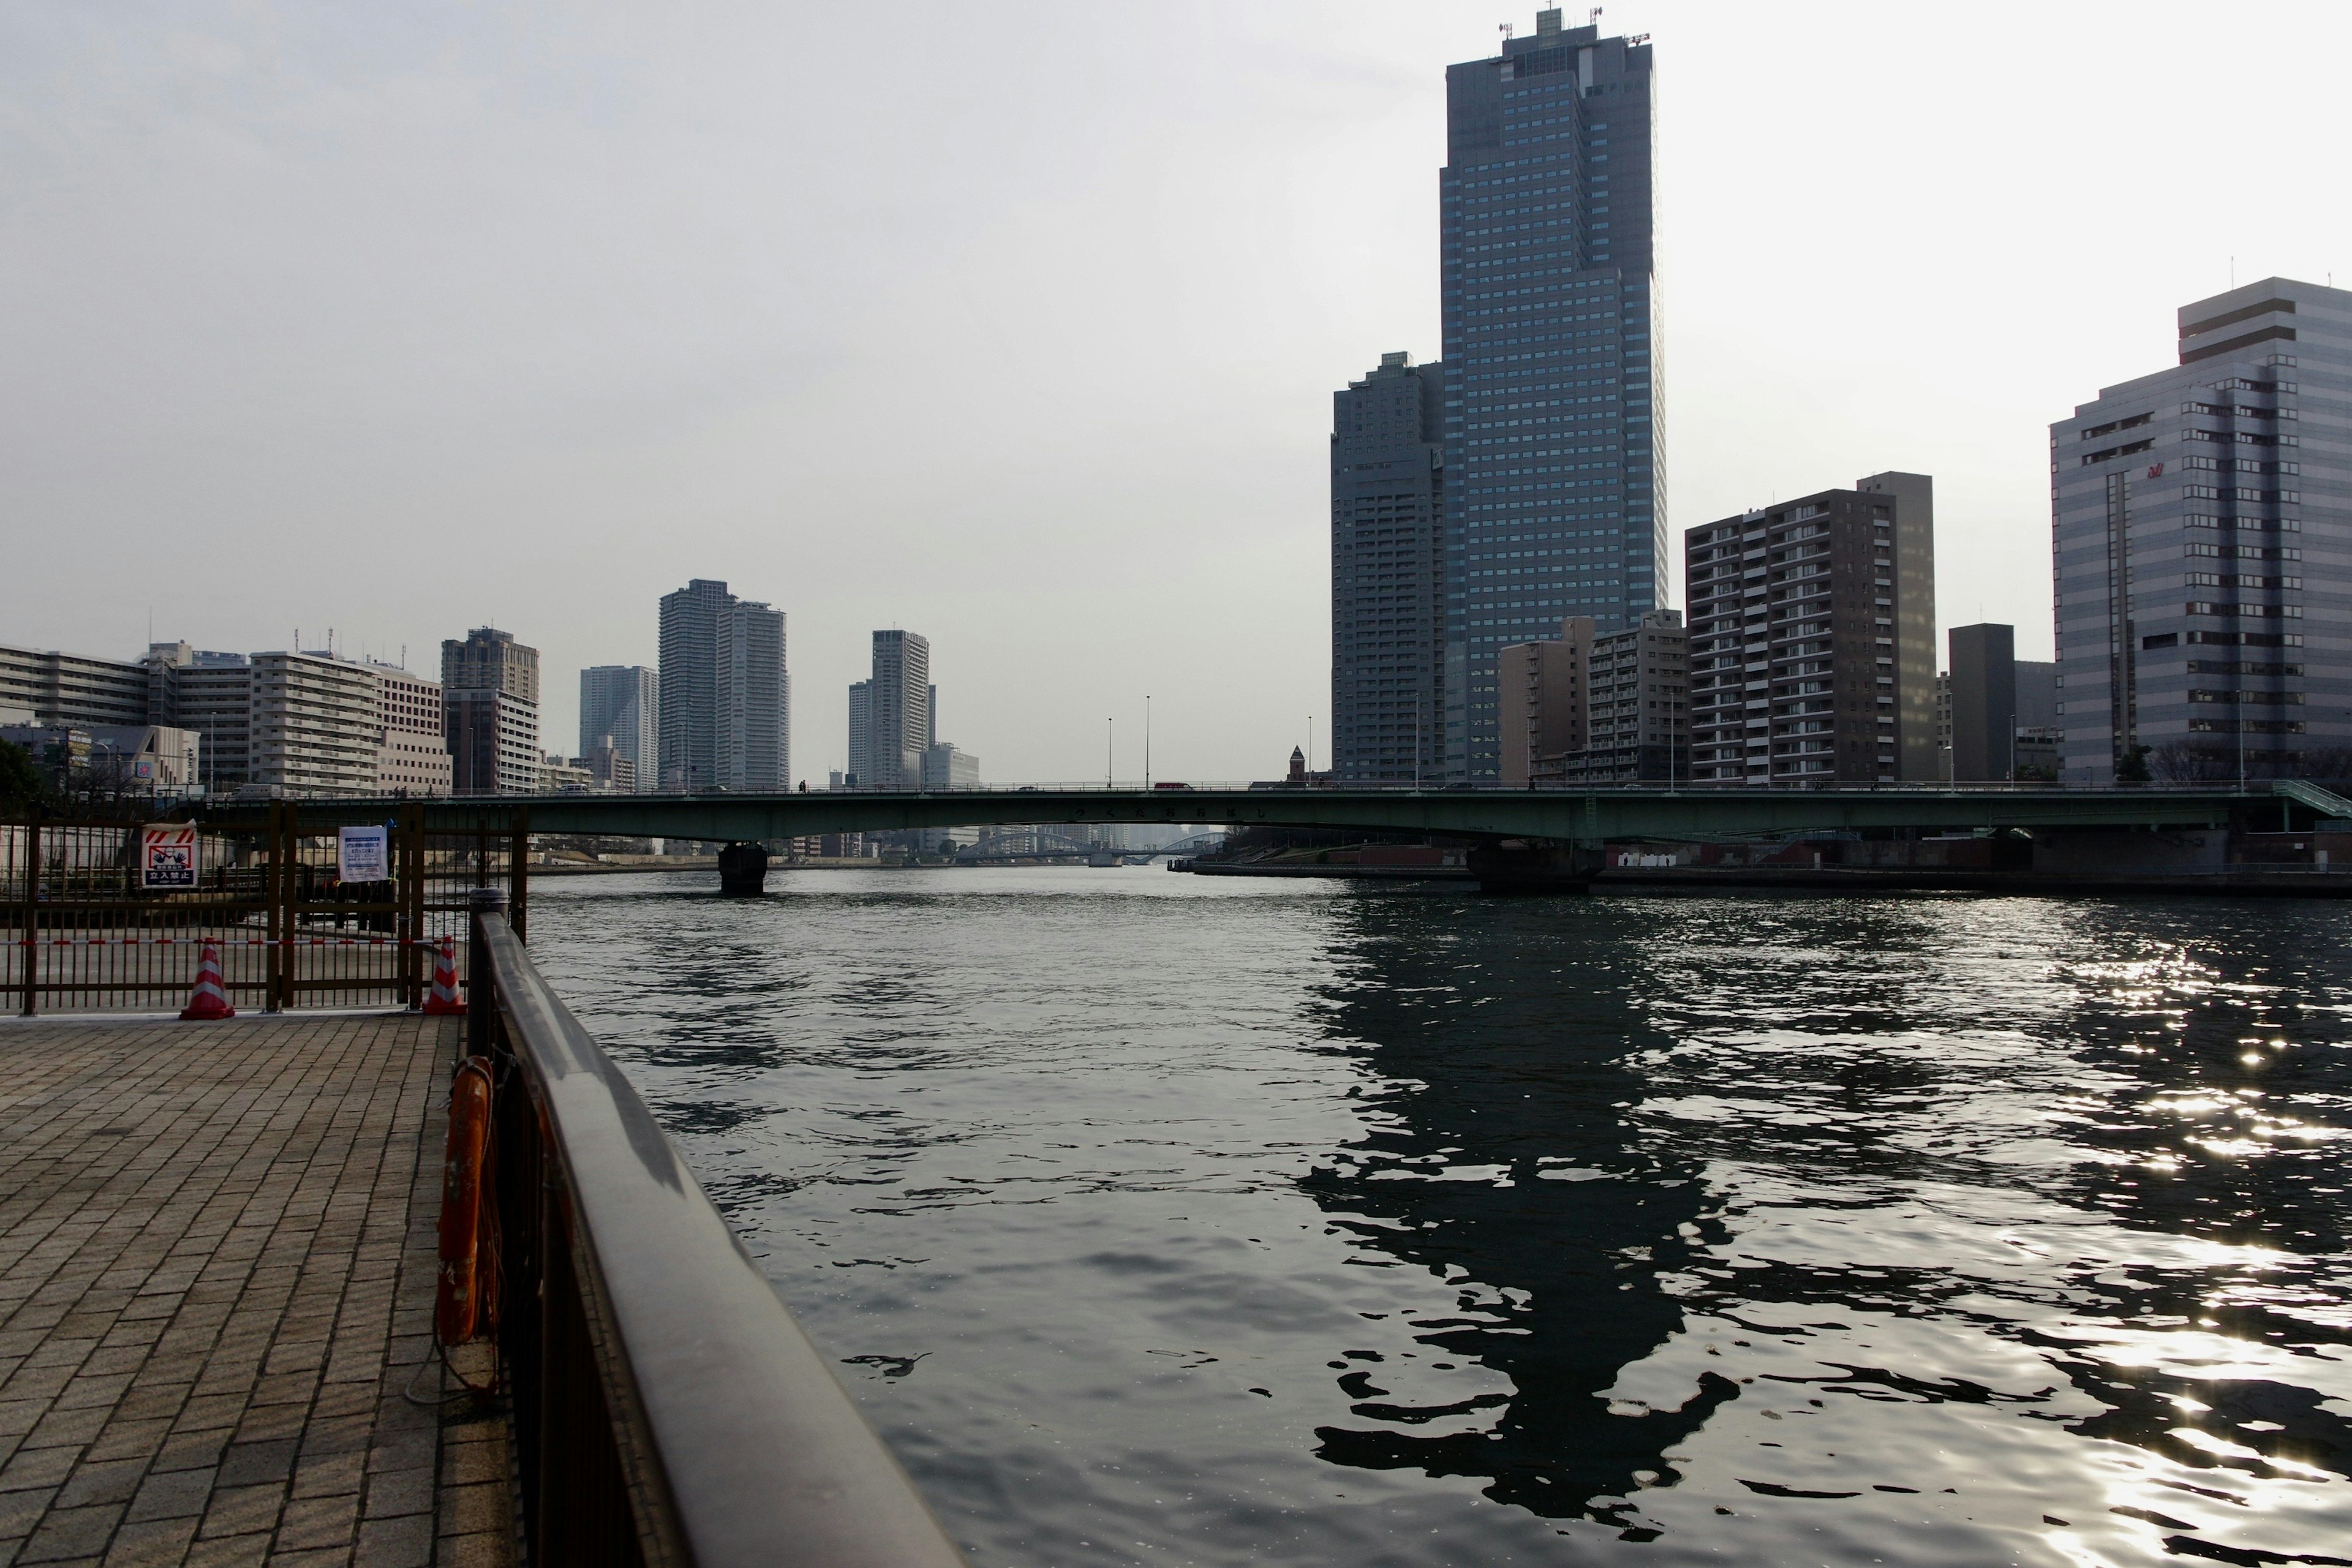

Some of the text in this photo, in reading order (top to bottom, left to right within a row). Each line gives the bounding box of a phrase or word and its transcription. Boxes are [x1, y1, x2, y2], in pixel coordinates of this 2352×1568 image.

[1075, 807, 1265, 818] つくだおおはし
